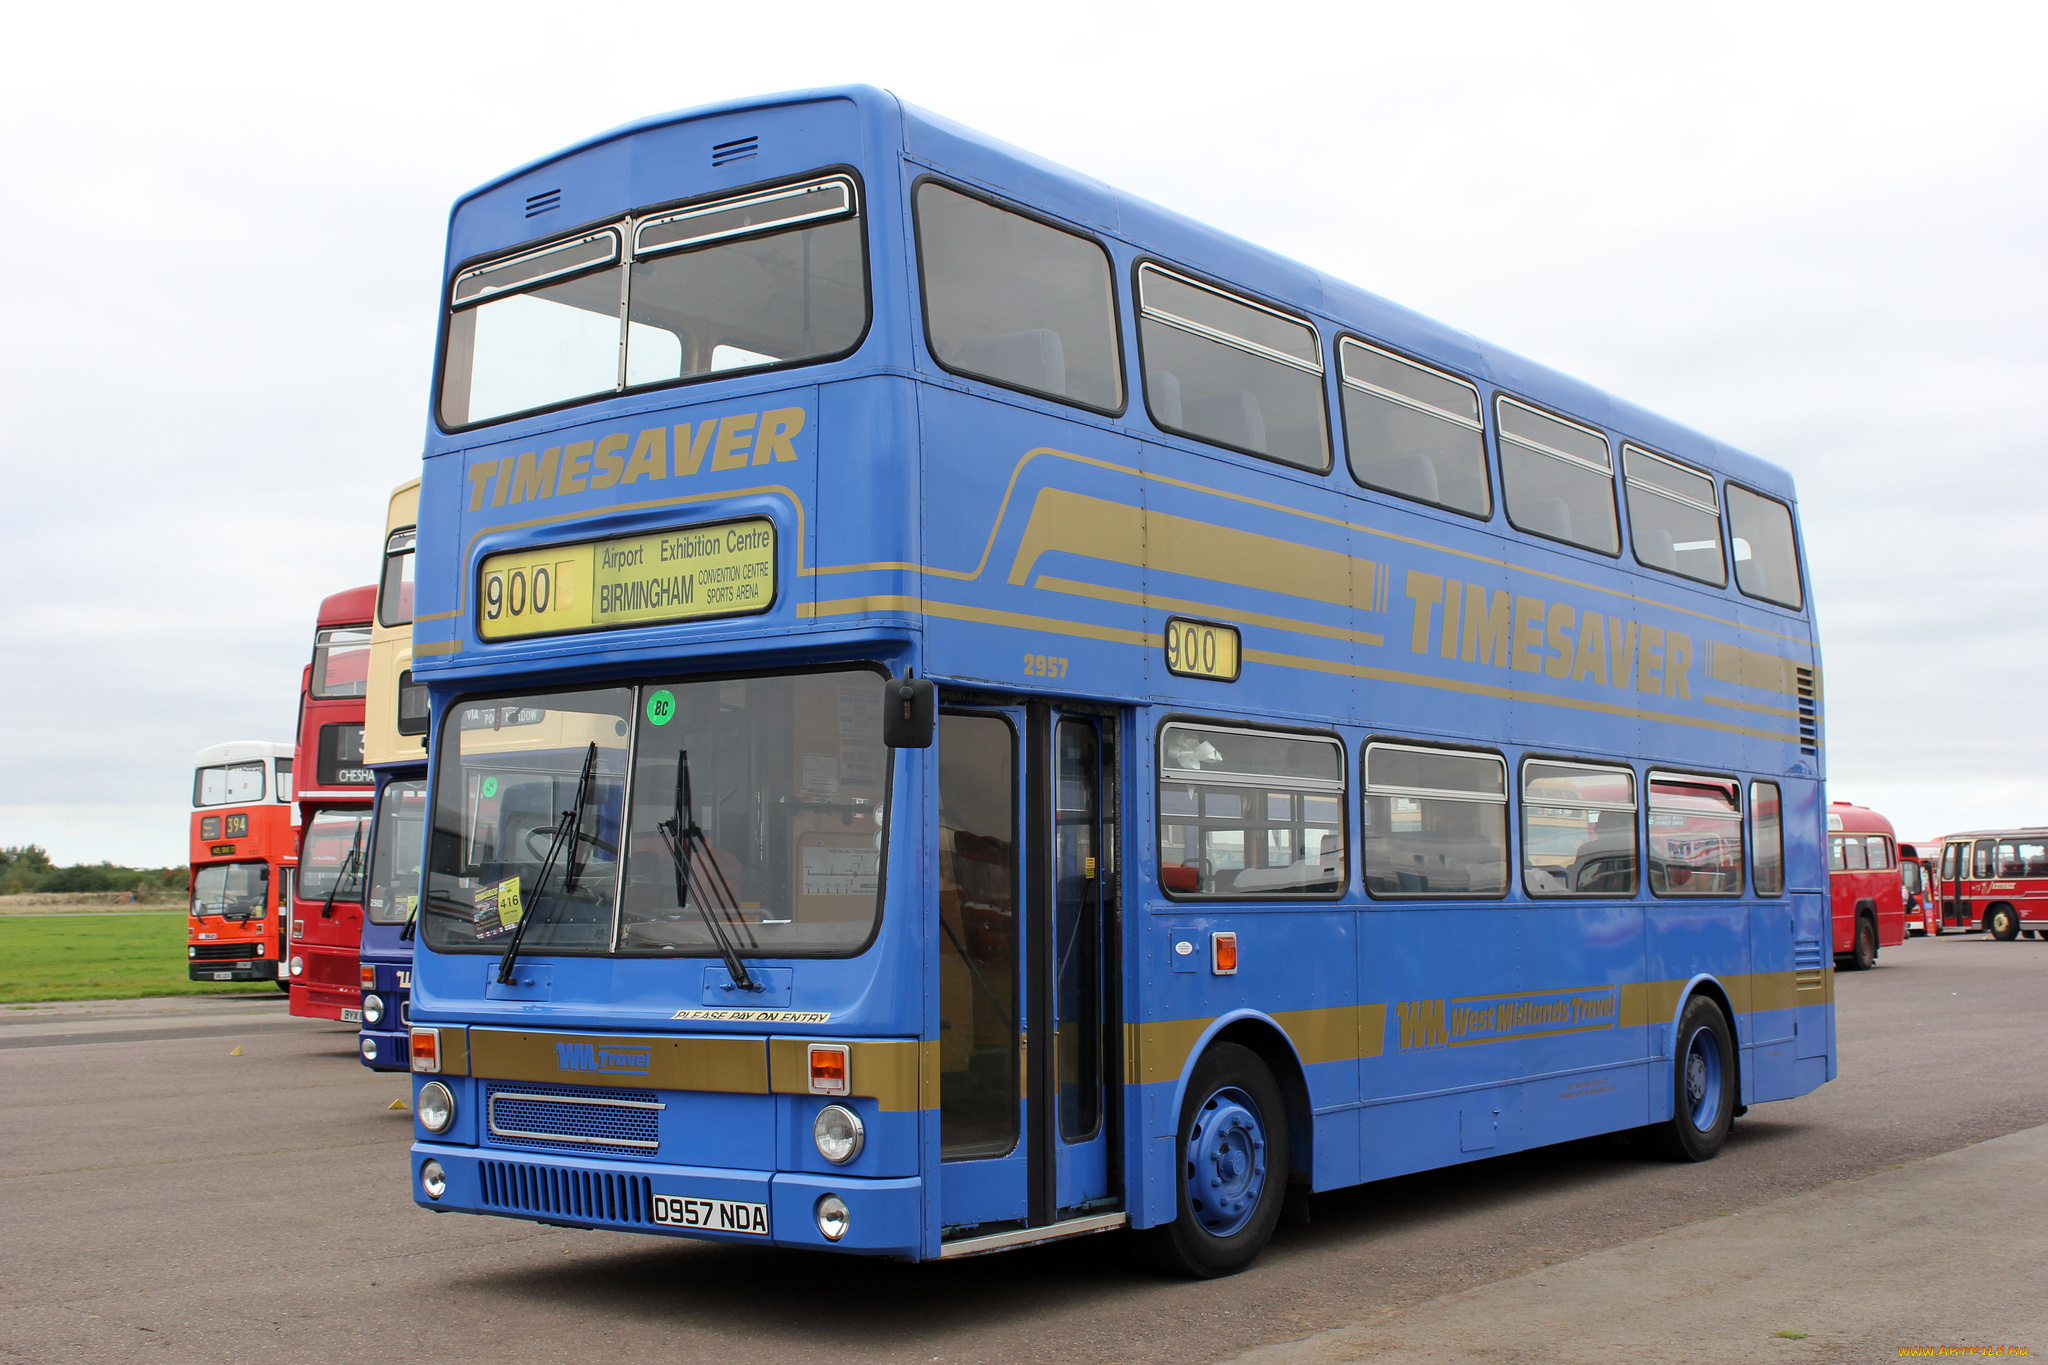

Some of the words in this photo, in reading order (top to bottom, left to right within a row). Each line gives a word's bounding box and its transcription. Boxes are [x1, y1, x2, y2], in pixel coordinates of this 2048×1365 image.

[467, 407, 805, 512] TIMESAVER
[602, 544, 643, 572] Airport
[661, 534, 720, 561] Exhibition
[727, 528, 769, 553] Centre
[699, 565, 740, 585] CONVENTION
[743, 561, 768, 580] CENTRE
[487, 568, 550, 619] 900
[600, 574, 694, 613] BIRMINGHAM
[707, 586, 733, 604] SPORTS
[737, 583, 759, 600] ARENA
[1405, 569, 1693, 700] TIMESAVER
[1169, 624, 1216, 673] 900
[1024, 653, 1068, 678] 2957
[466, 709, 479, 720] VIA
[655, 700, 669, 716] BC
[339, 769, 375, 782] CHESHA
[227, 817, 246, 833] 394
[370, 898, 383, 908] 2502
[500, 894, 519, 909] 416
[675, 1010, 728, 1020] PLEASE
[729, 1011, 754, 1020] PAY
[756, 1012, 779, 1021] ON
[780, 1012, 829, 1023] ENTRY
[1451, 1006, 1494, 1037] West
[1496, 999, 1569, 1032] Midlands
[1571, 994, 1615, 1023] Travel
[598, 1051, 651, 1068] Travel
[654, 1197, 713, 1226] D957
[720, 1203, 766, 1231] NDA
